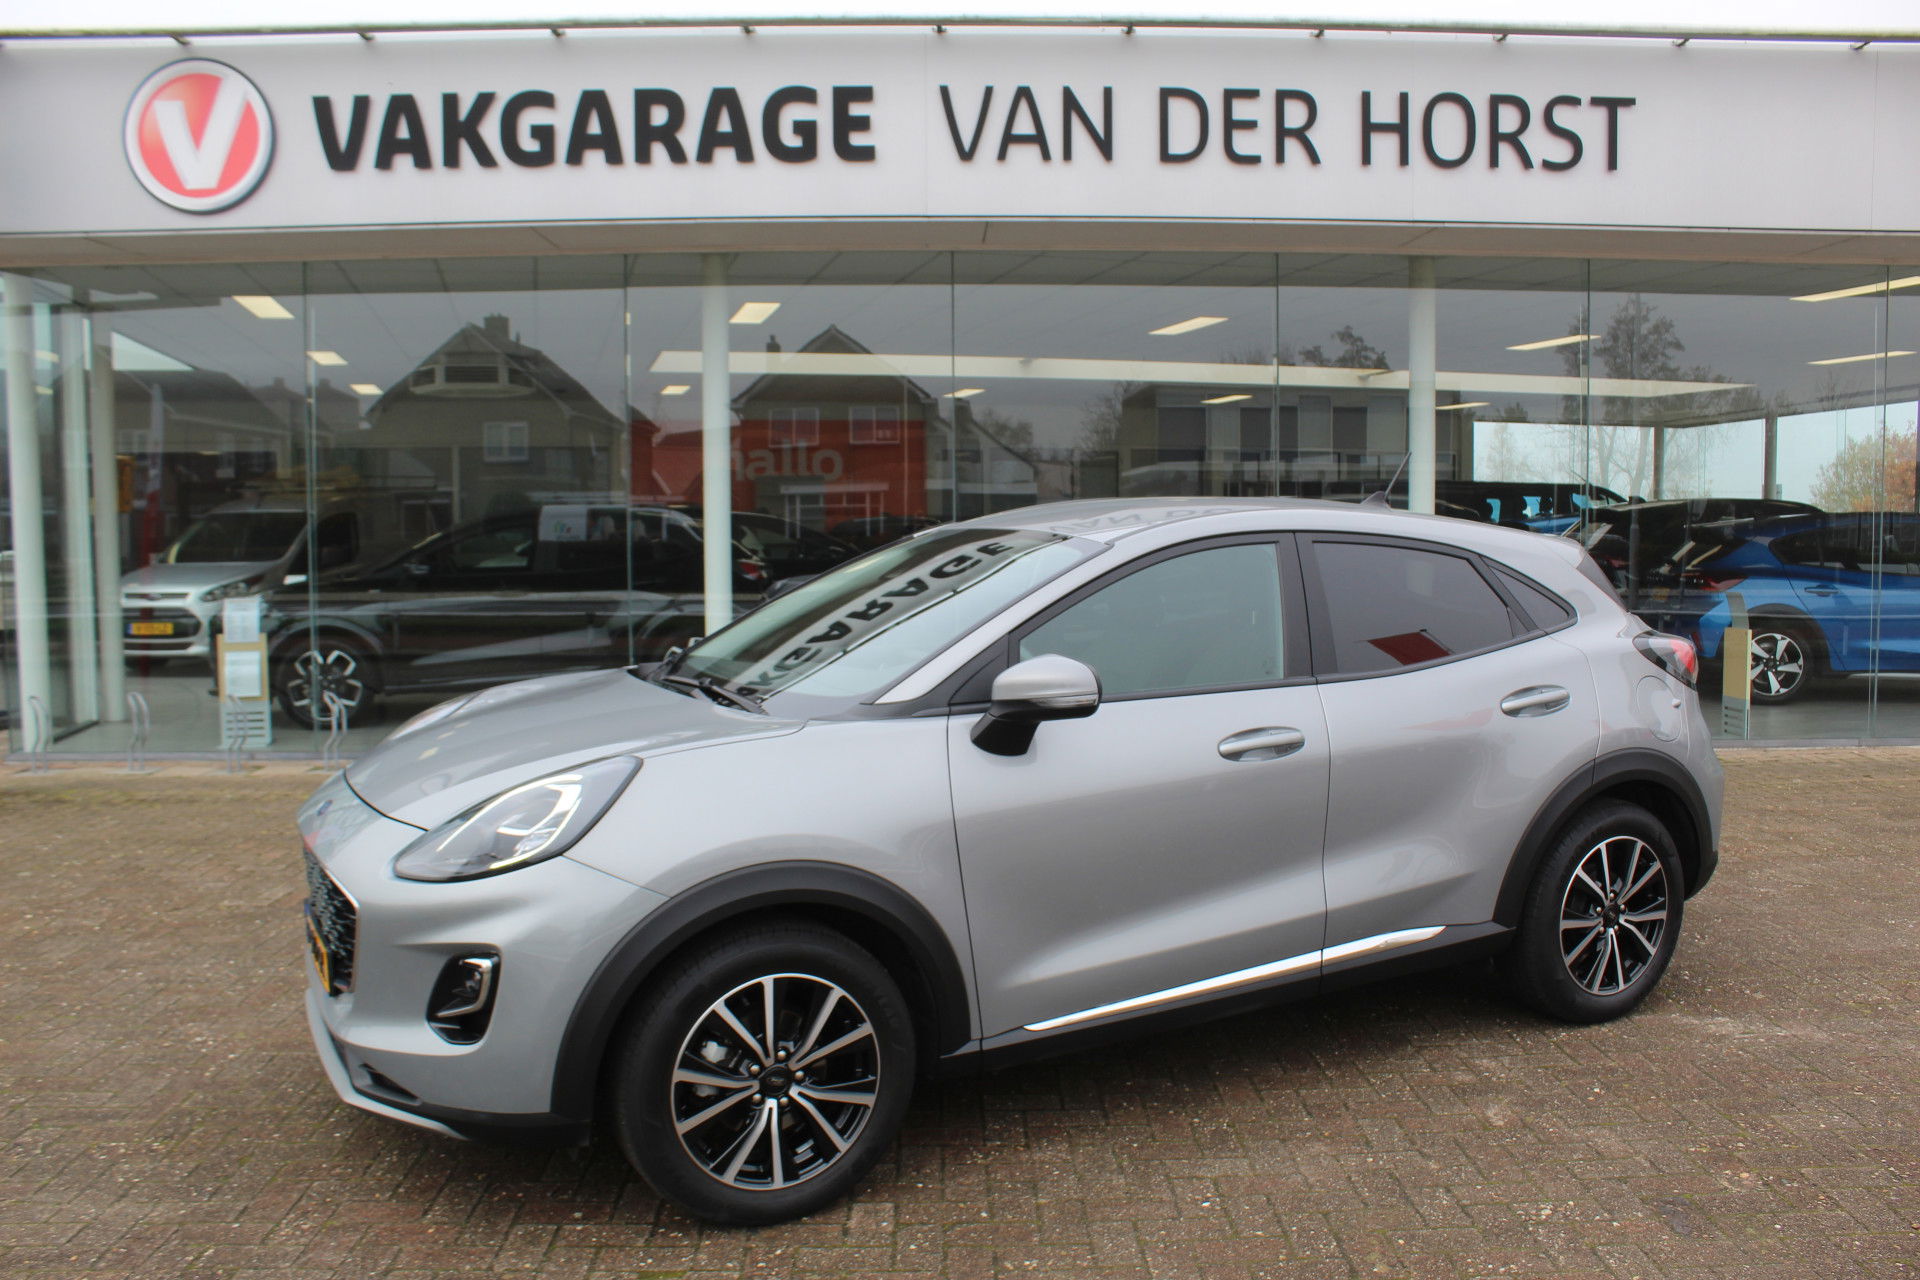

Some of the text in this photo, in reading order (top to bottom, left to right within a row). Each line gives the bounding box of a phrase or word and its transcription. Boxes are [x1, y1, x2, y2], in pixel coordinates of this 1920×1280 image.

[312, 84, 1637, 173] VAKGARAGE VAN DER HORST
